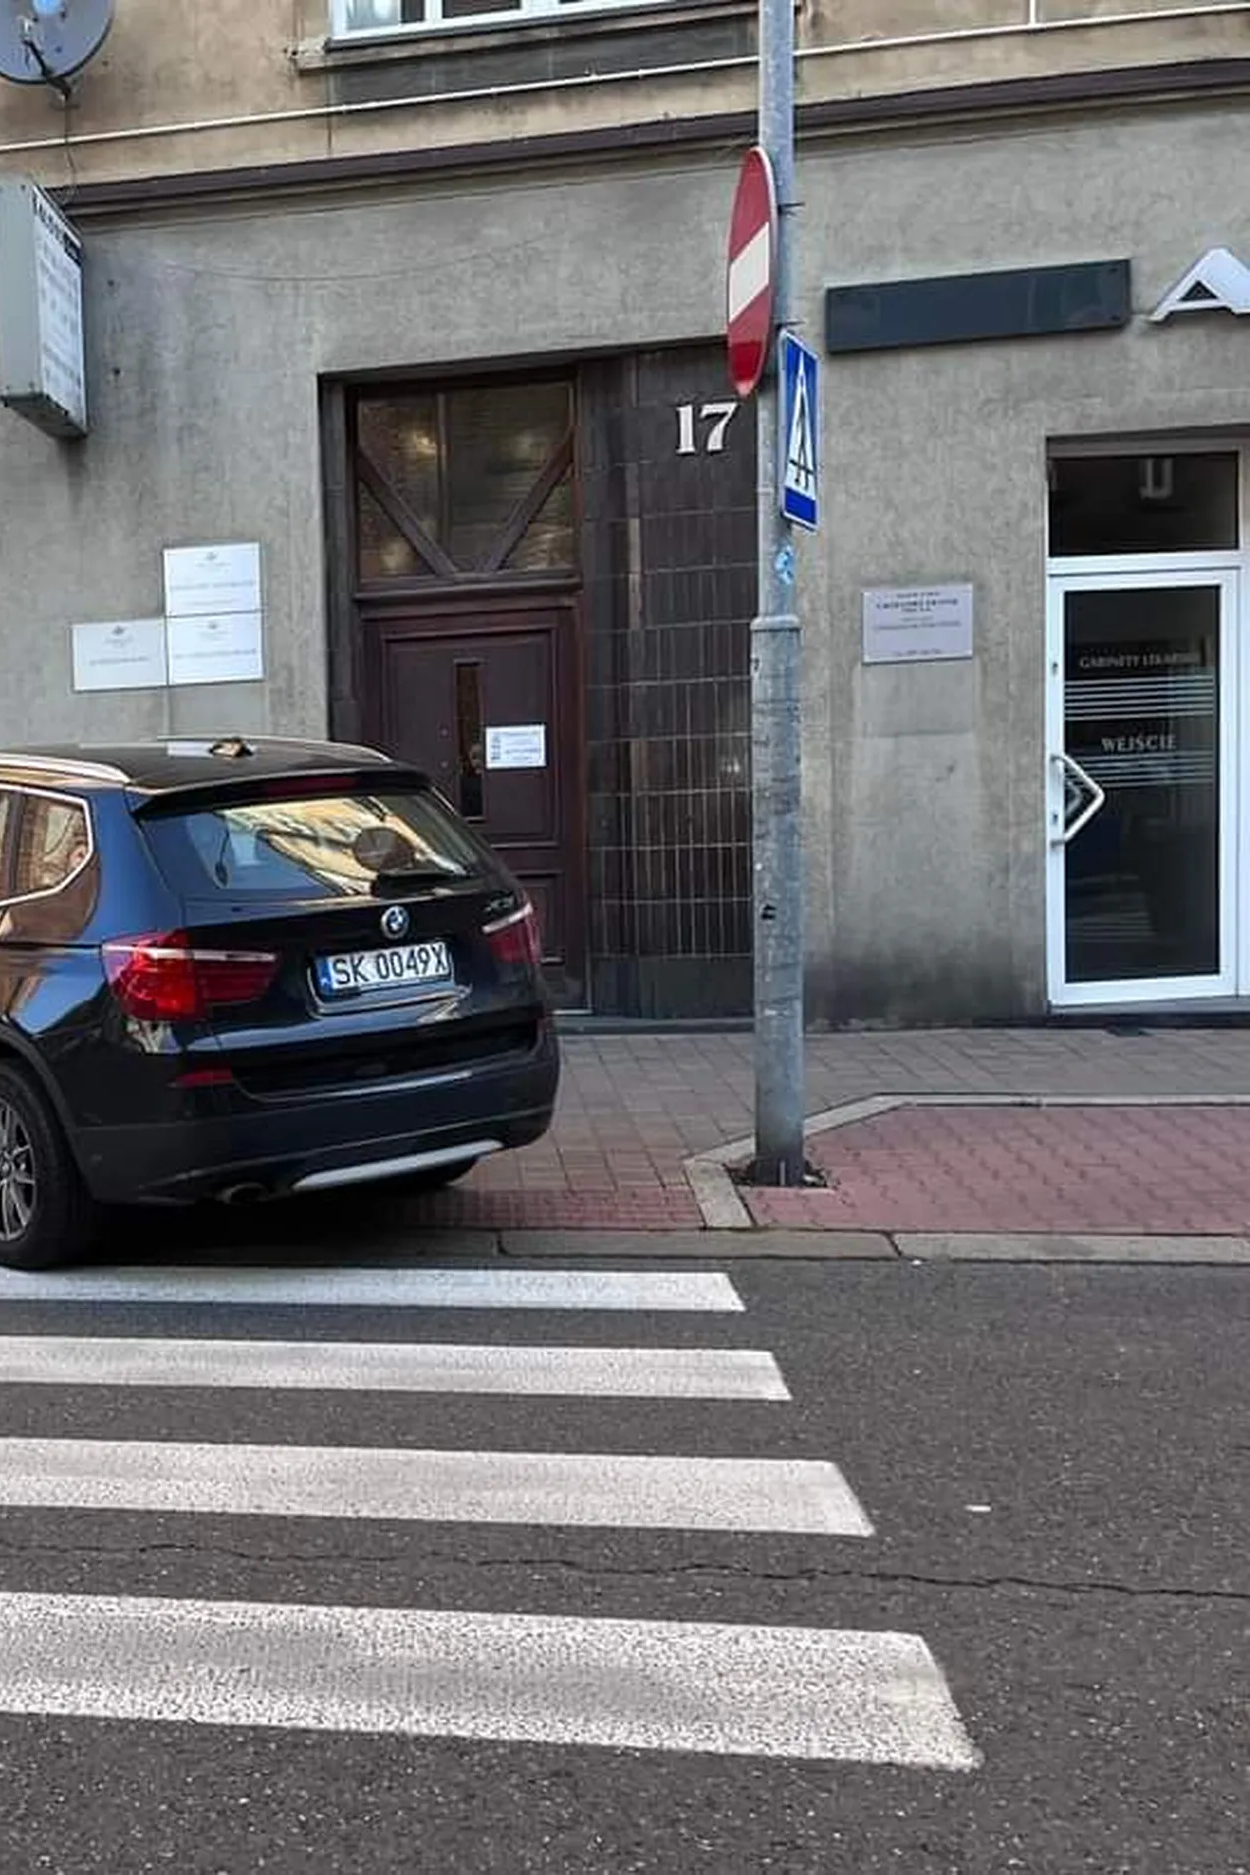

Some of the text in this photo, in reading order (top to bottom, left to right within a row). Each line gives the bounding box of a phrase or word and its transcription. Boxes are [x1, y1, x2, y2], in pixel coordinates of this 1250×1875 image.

[676, 402, 738, 454] 17
[1101, 732, 1177, 752] WEJŚCIE
[332, 954, 369, 985] SK
[376, 945, 448, 980] 0049X
